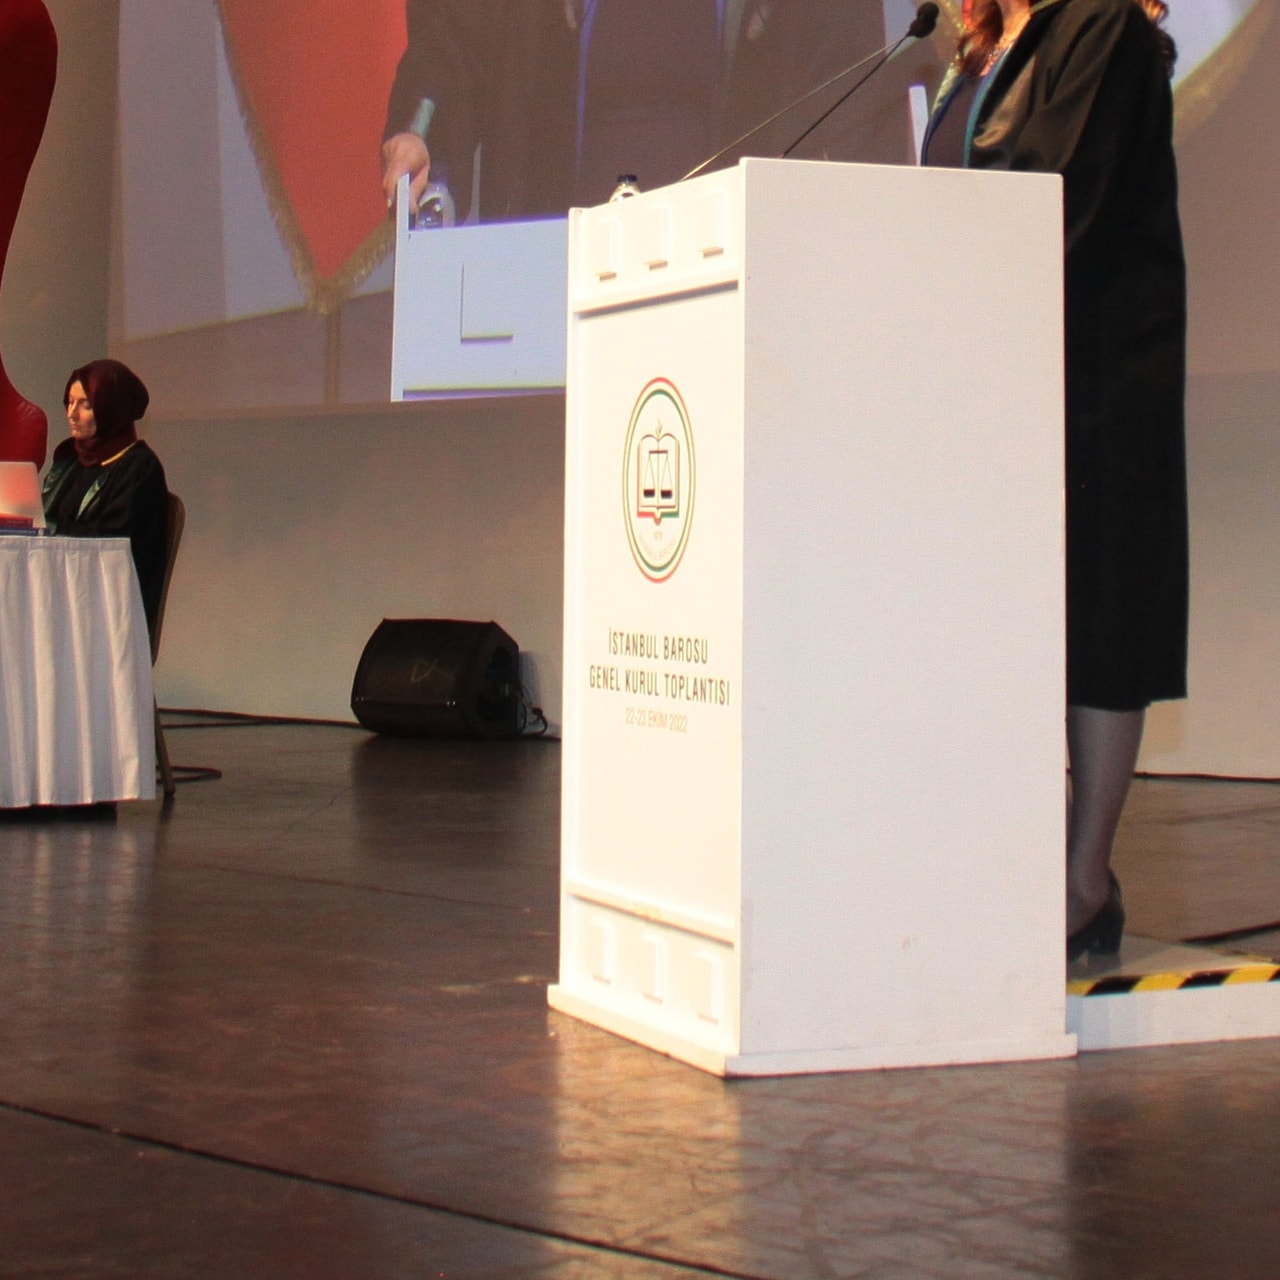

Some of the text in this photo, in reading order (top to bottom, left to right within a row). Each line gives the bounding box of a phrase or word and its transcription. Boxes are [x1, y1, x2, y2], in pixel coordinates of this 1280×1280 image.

[608, 625, 708, 664] İSTANBUL BAROSU
[589, 664, 730, 706] GENEL KURUL TOPLANTISI
